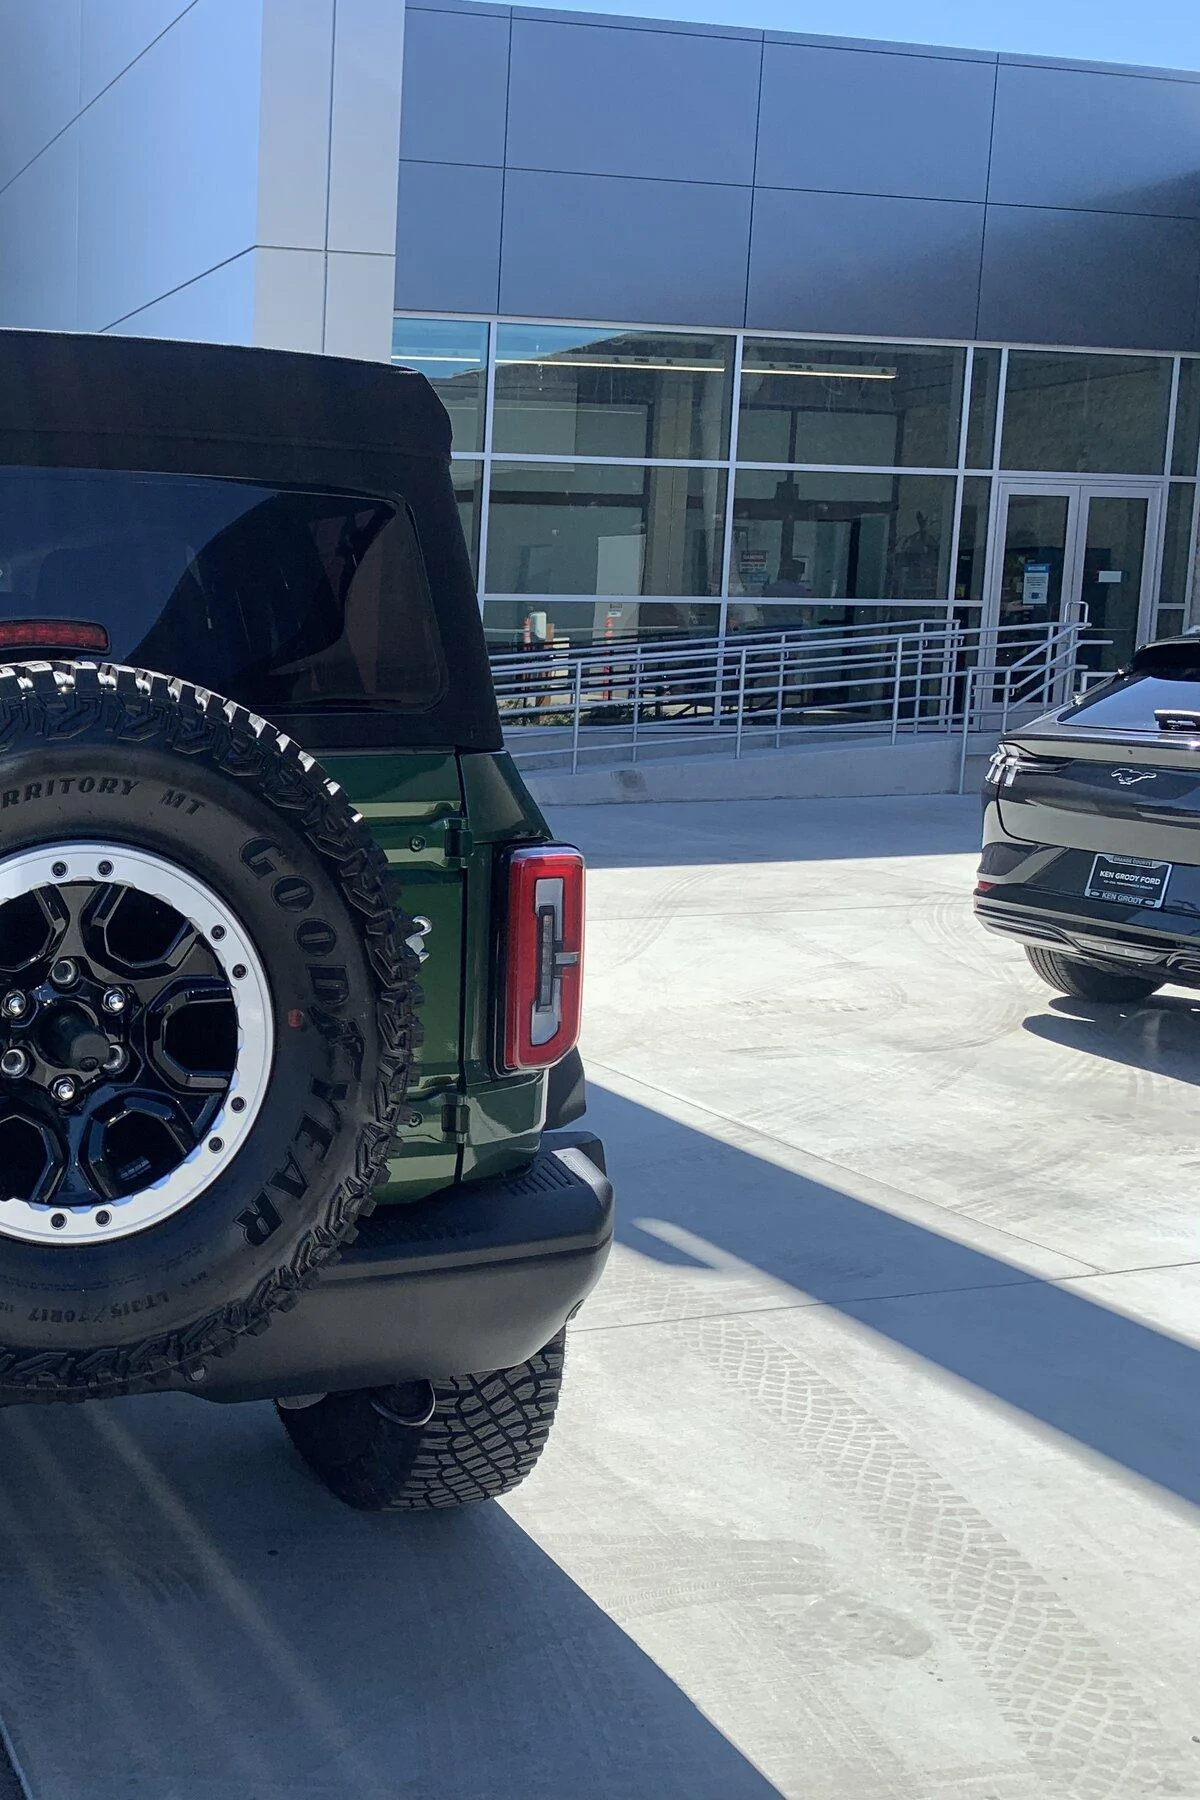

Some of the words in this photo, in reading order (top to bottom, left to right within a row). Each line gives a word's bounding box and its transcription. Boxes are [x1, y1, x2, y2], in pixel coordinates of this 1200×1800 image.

[158, 789, 207, 815] MT
[1099, 870, 1115, 878] KEN
[1115, 872, 1140, 882] GRODY
[1140, 876, 1161, 885] FORD
[1101, 892, 1117, 900] KEN
[1117, 894, 1143, 904] GRODY
